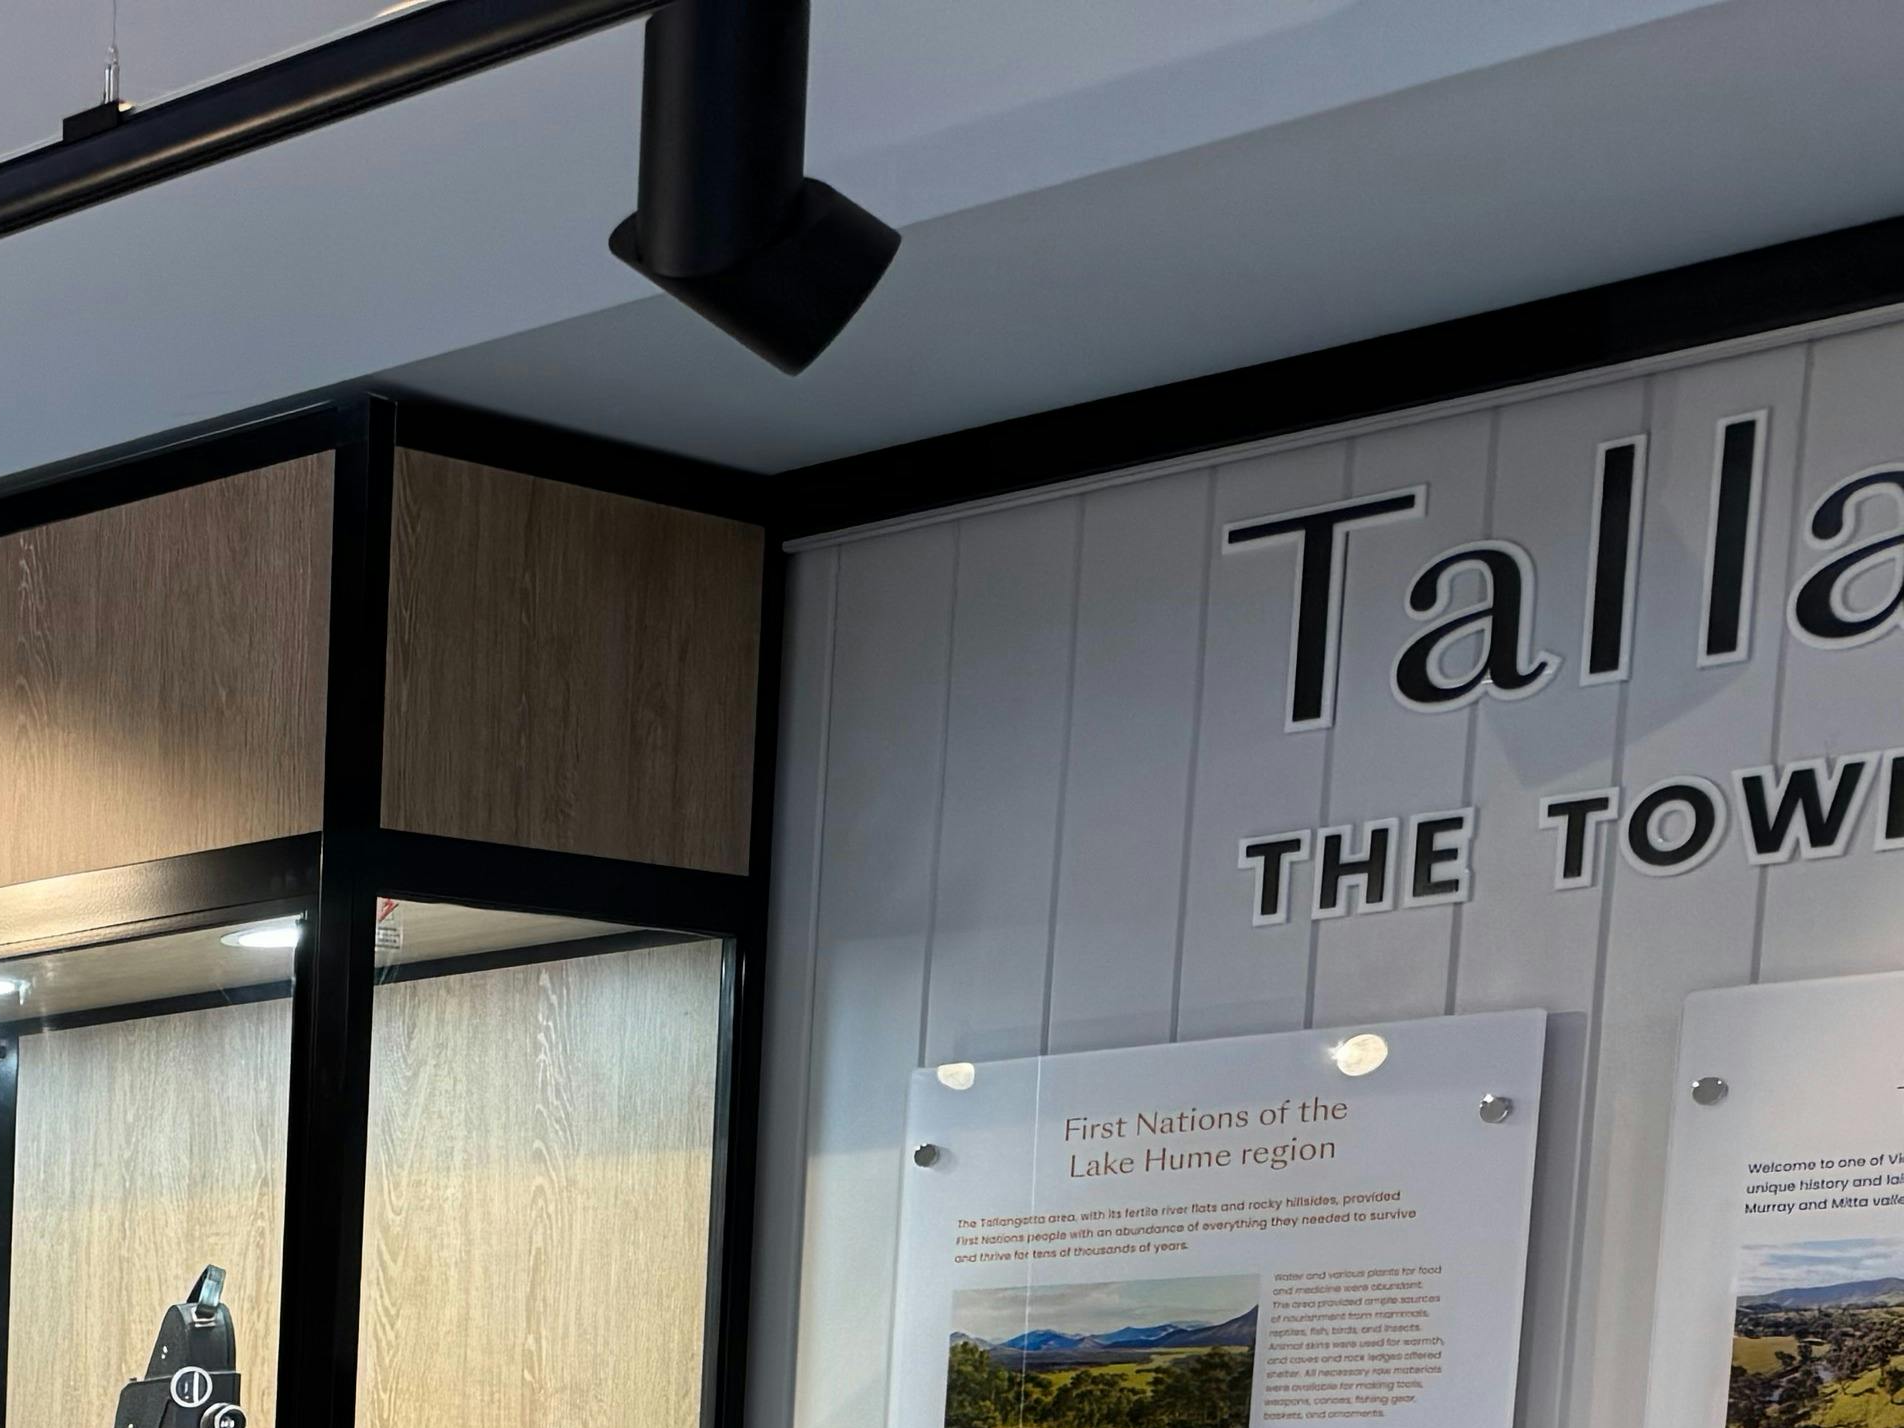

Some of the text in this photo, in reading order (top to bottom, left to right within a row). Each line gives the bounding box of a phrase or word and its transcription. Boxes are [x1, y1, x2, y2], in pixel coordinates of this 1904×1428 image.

[1242, 812, 1471, 920] THE
[1065, 1096, 1348, 1142] First Nations of the
[1070, 1136, 1335, 1178] Lake Hume region
[1748, 1153, 1885, 1174] Welcome to one of
[1746, 1174, 1882, 1196] unique history and
[1745, 1197, 1869, 1215] Murray and Mitta
